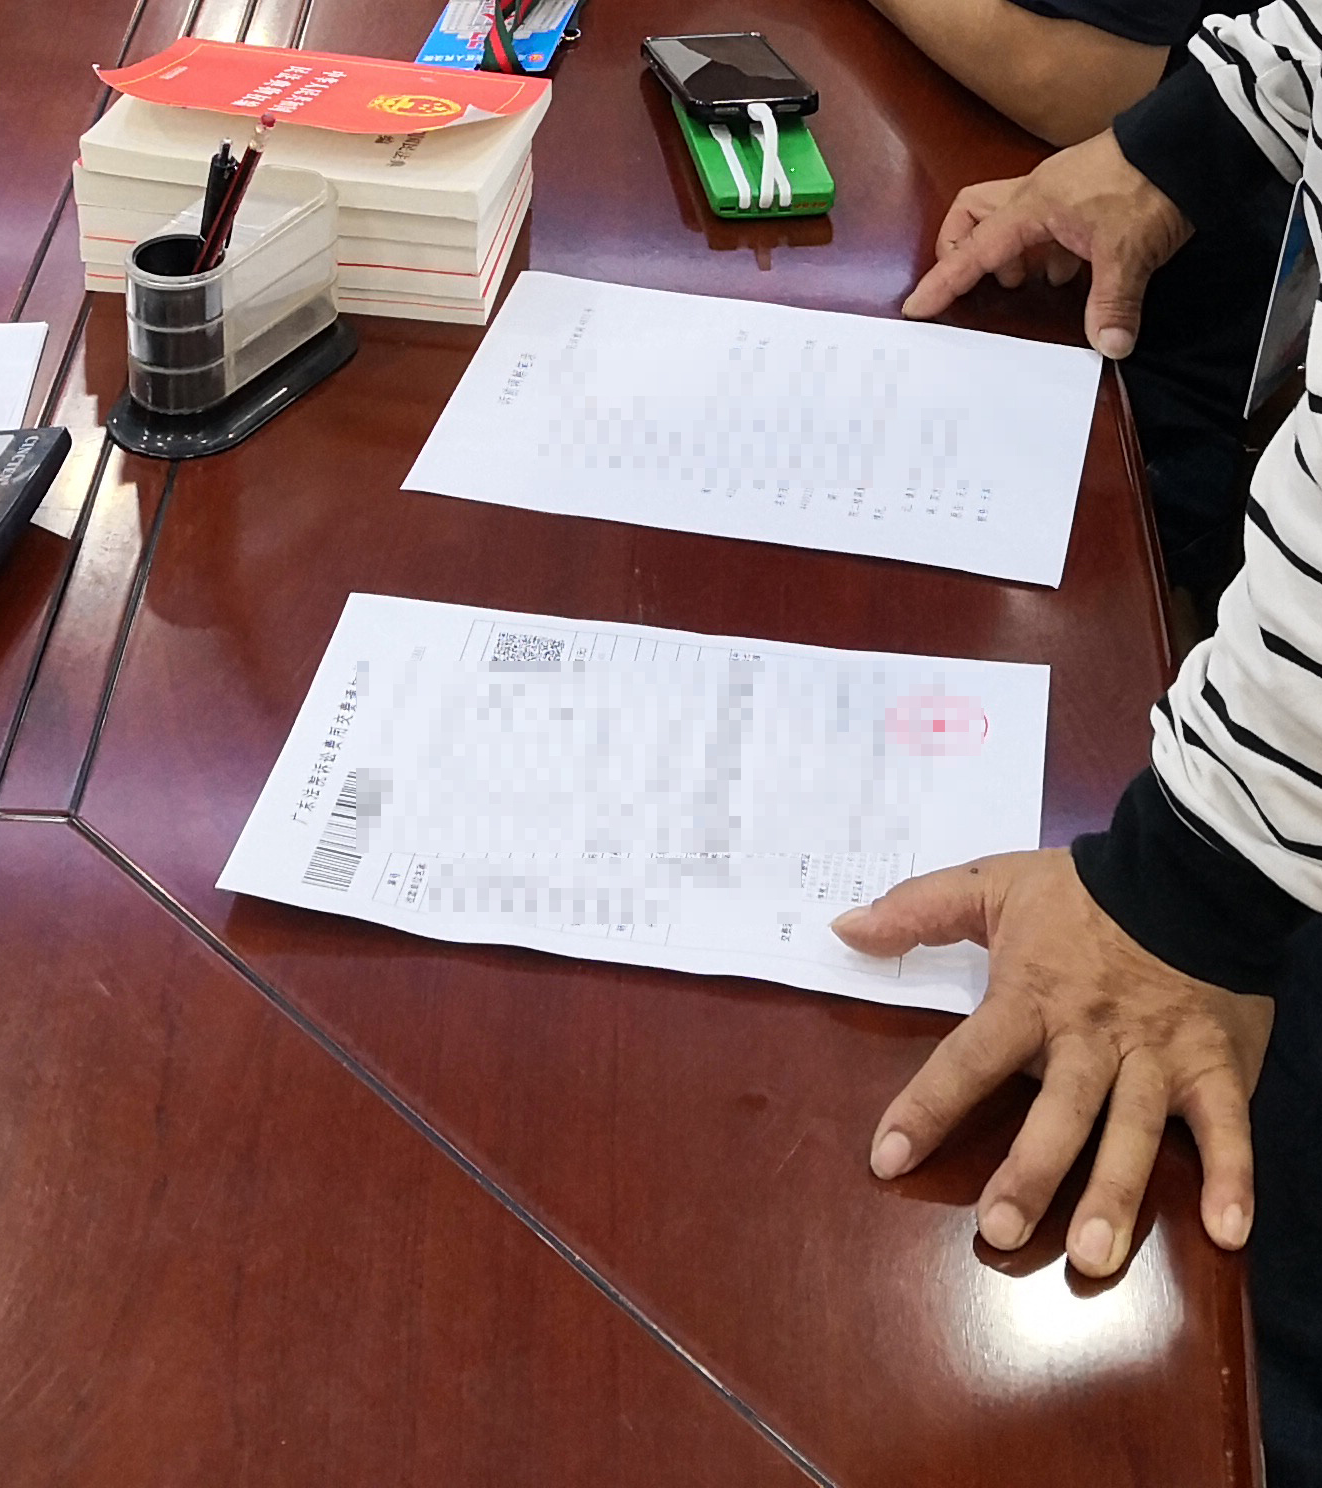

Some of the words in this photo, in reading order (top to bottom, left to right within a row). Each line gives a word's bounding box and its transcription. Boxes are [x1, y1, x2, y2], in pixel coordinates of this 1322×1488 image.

[267, 70, 348, 113] 中华人民共和国
[291, 664, 358, 825] 广东法院诉讼费用交费通
